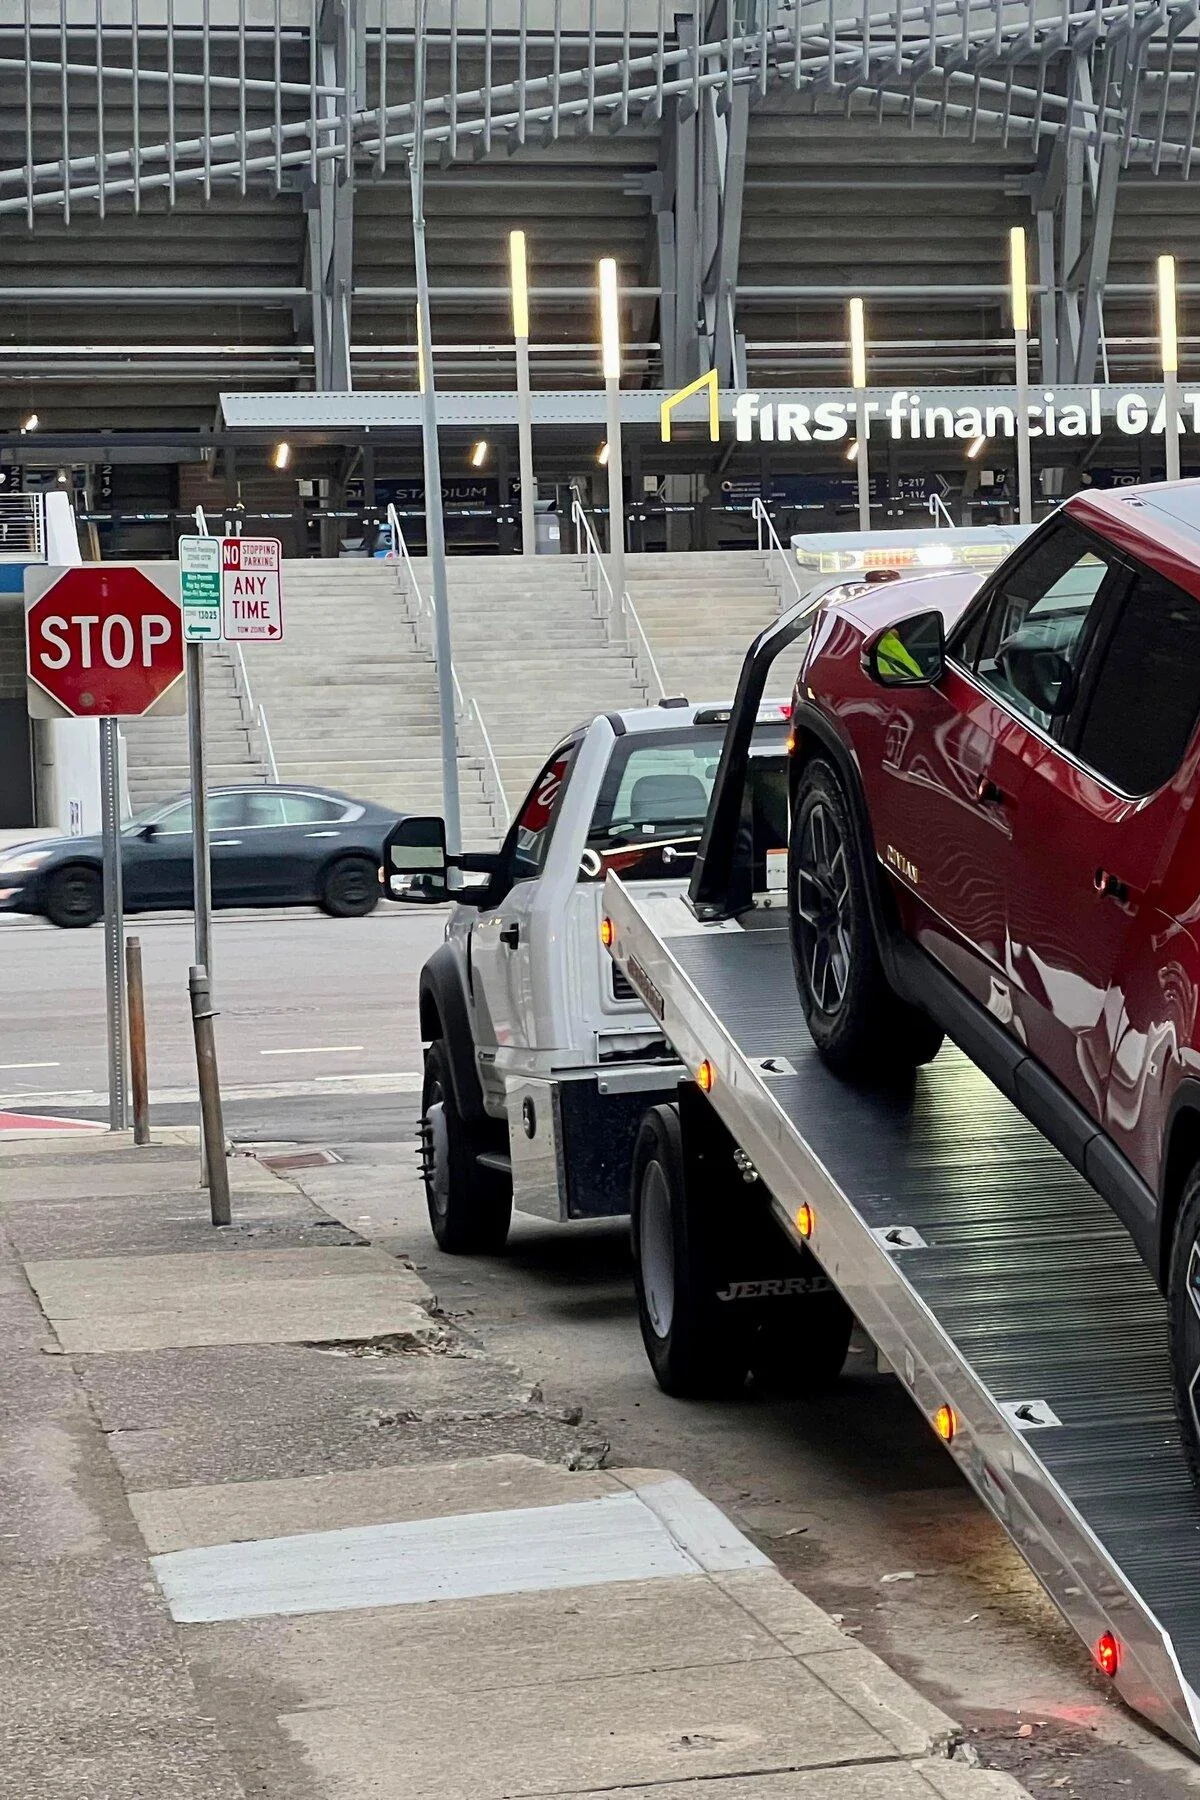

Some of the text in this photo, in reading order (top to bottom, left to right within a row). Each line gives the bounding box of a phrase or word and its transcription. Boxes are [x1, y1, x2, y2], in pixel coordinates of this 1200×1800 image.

[886, 389, 1101, 438] financial
[223, 545, 275, 565] NO STOPPING
[244, 556, 274, 567] PARKING
[233, 576, 267, 596] ANY
[232, 600, 270, 619] TIME
[250, 626, 266, 634] ZONE
[40, 614, 172, 670] STOP
